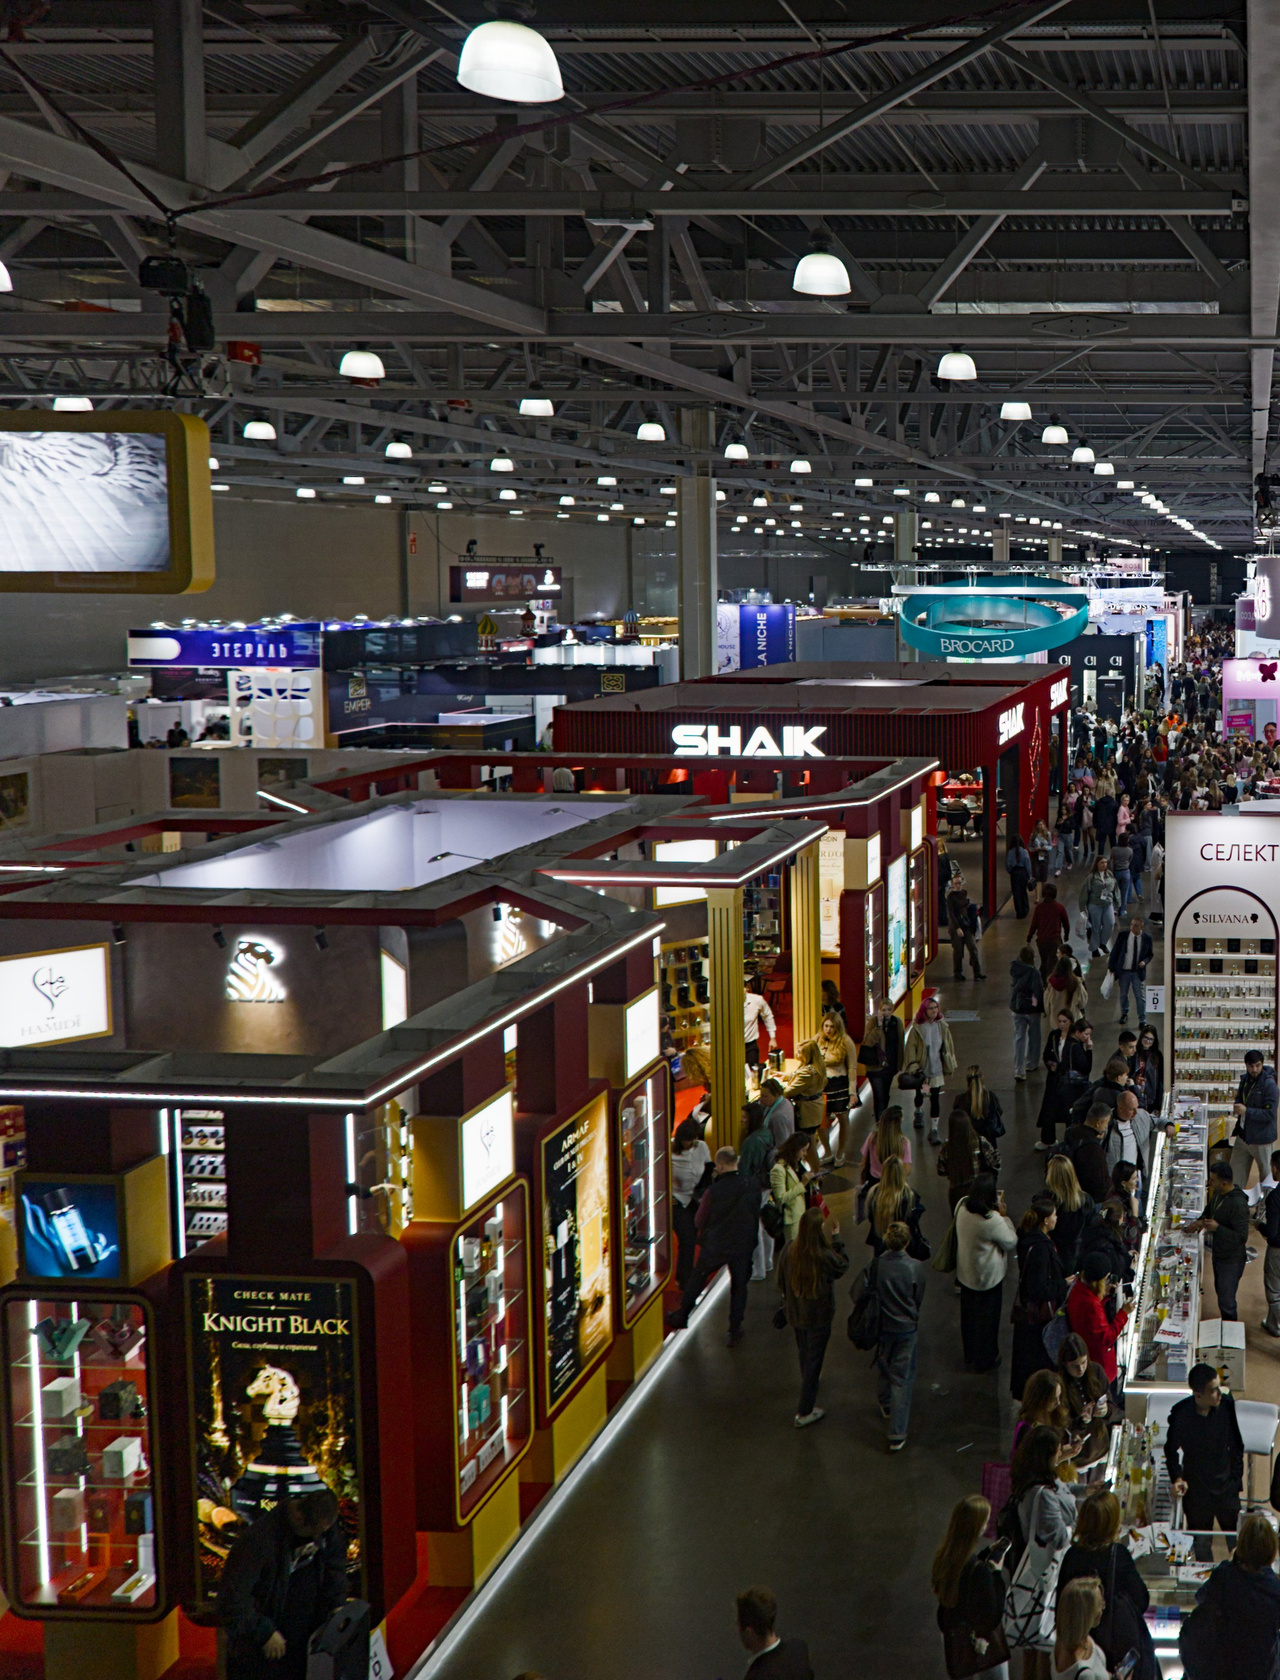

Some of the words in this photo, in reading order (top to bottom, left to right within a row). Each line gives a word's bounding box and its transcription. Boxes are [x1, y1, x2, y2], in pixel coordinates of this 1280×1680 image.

[756, 612, 767, 650] NICHE
[211, 642, 288, 658] ЭТЕРАЛЬ
[940, 638, 1015, 654] BROCARD
[344, 698, 371, 714] EMPER
[672, 725, 828, 757] SHAIK
[1201, 913, 1250, 924] SILVANA
[1152, 997, 1159, 1005] D
[561, 1120, 590, 1152] ARMAF
[233, 1290, 275, 1300] CHECK
[279, 1292, 312, 1302] MATE
[202, 1312, 286, 1333] KNIGHT
[289, 1315, 350, 1335] BLACK
